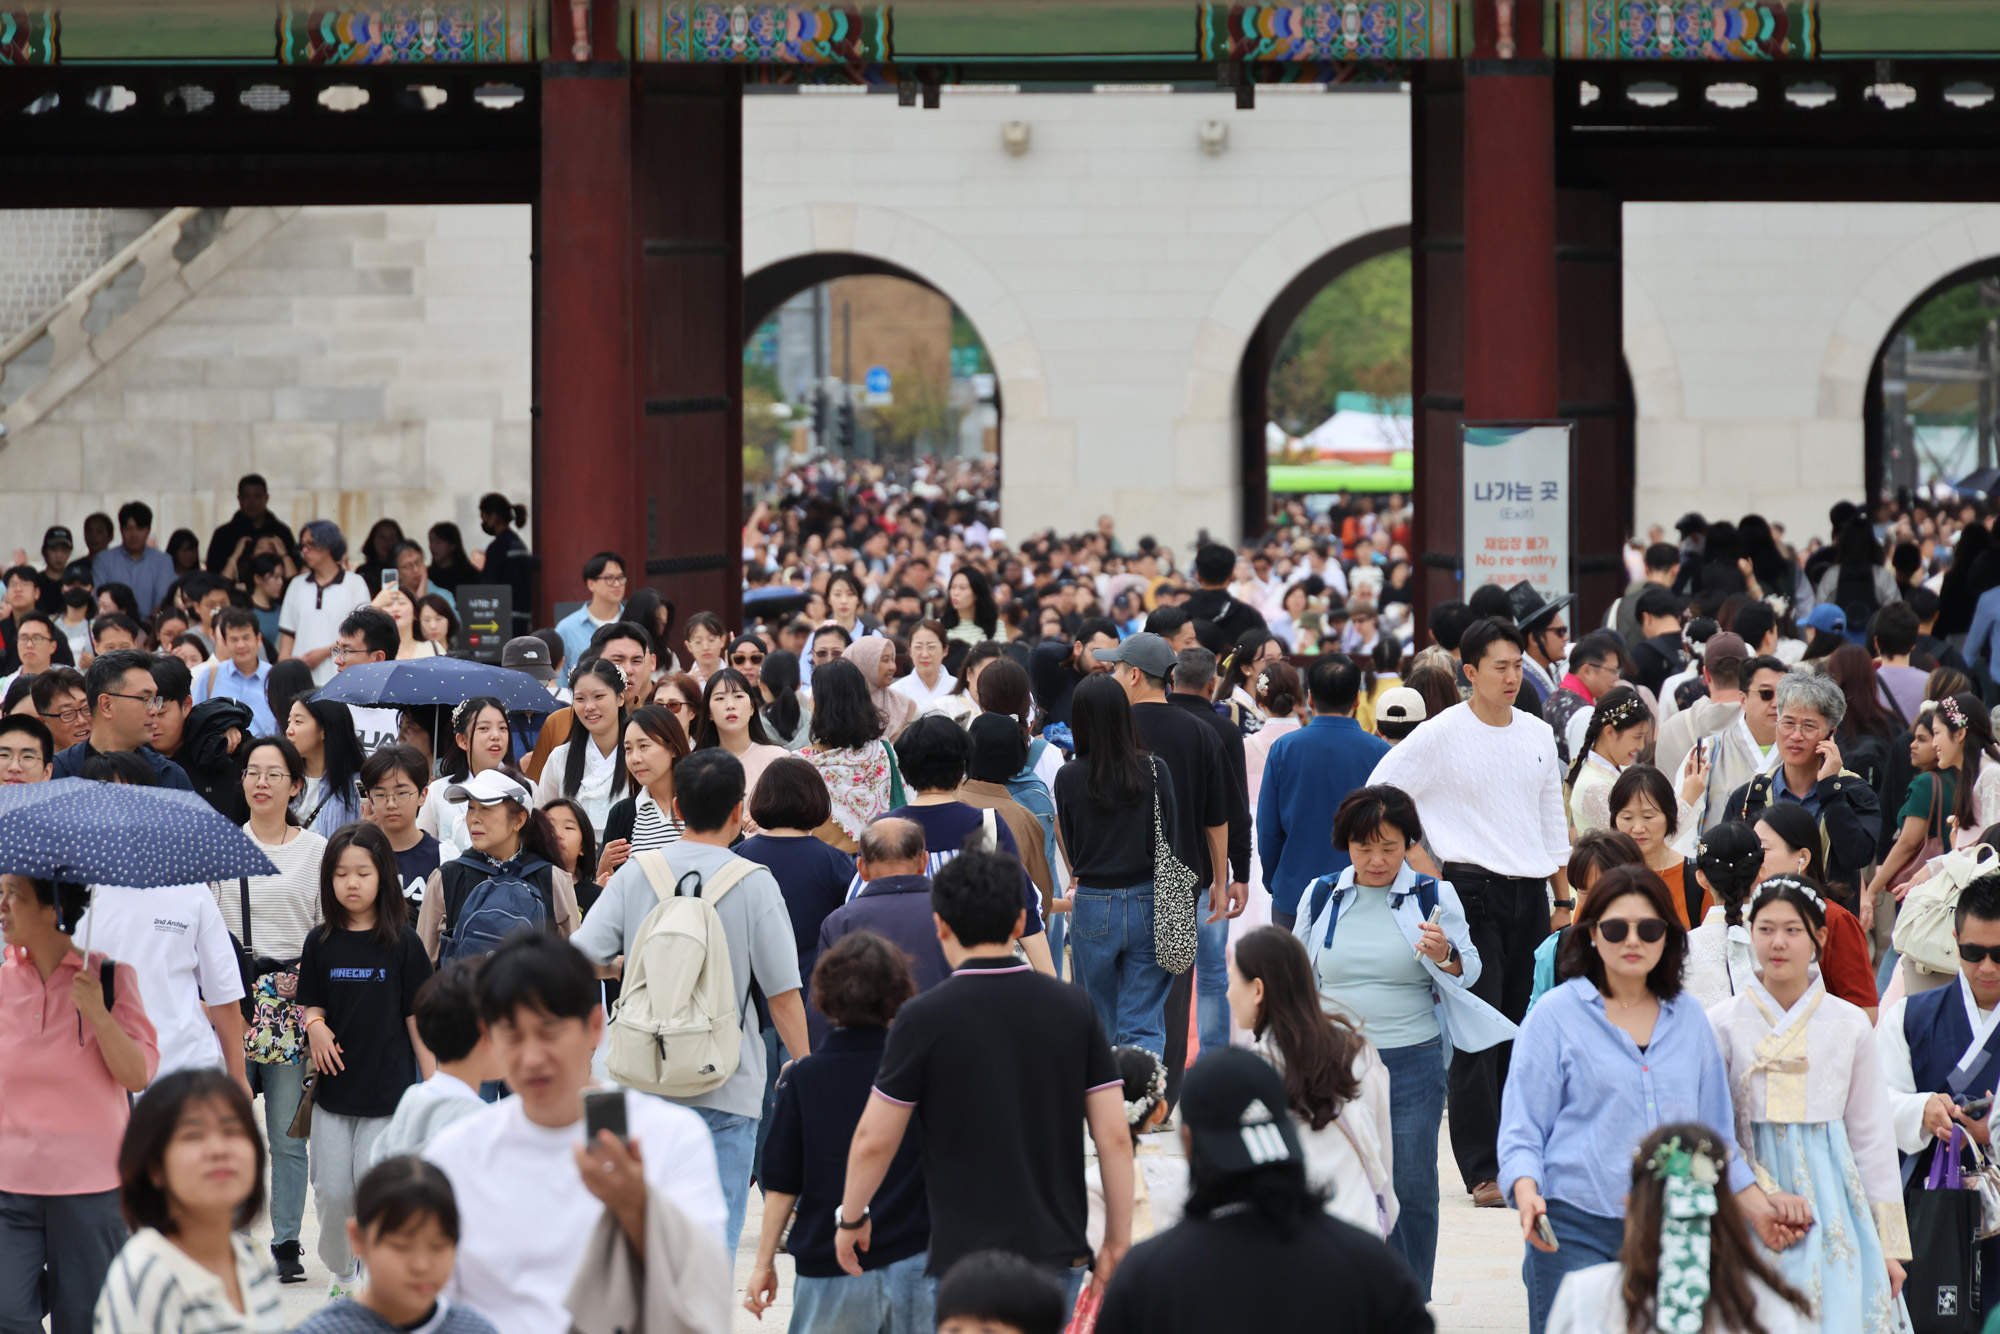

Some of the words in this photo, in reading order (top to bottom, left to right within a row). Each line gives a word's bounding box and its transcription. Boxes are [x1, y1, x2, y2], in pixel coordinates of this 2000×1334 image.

[1474, 481, 1533, 501] 나가는
[1540, 481, 1559, 501] 곳
[1500, 507, 1535, 521] (Exit)
[1485, 536, 1522, 550] 재입장
[1526, 536, 1549, 550] 불가
[1476, 553, 1497, 566] No
[1500, 553, 1558, 568] re-entry
